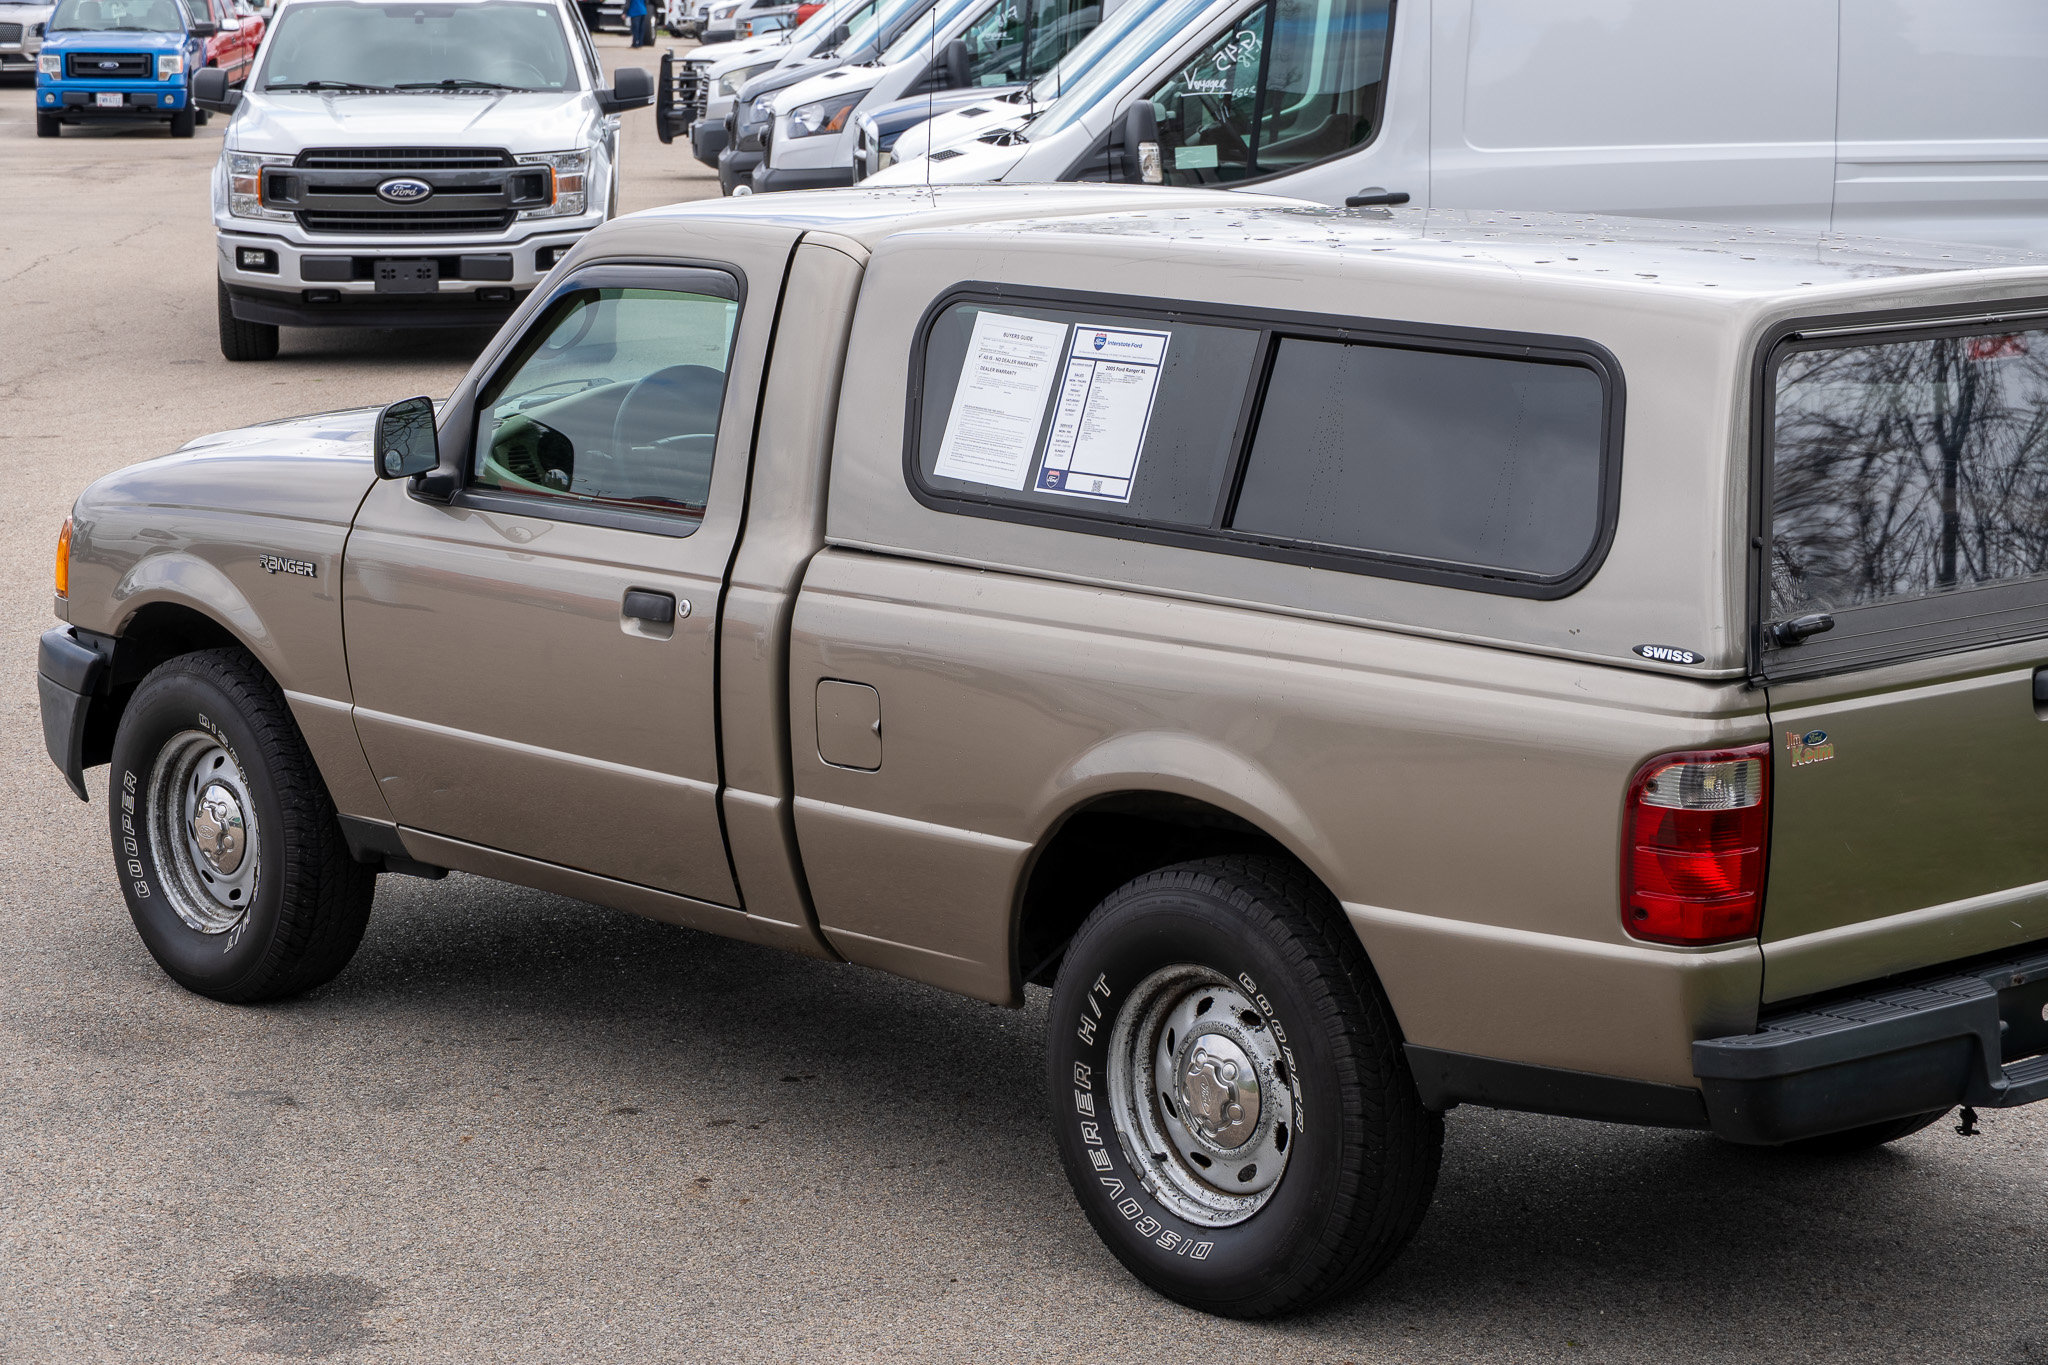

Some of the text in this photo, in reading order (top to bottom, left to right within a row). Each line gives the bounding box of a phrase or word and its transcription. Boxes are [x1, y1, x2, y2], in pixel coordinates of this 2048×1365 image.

[391, 184, 418, 196] Ford
[259, 554, 317, 578] RANGER
[1642, 645, 1694, 664] SWISS
[122, 770, 151, 899] COOPER
[1238, 972, 1306, 1134] COOPER
[1073, 972, 1214, 1262] DISCOVERER H/T
